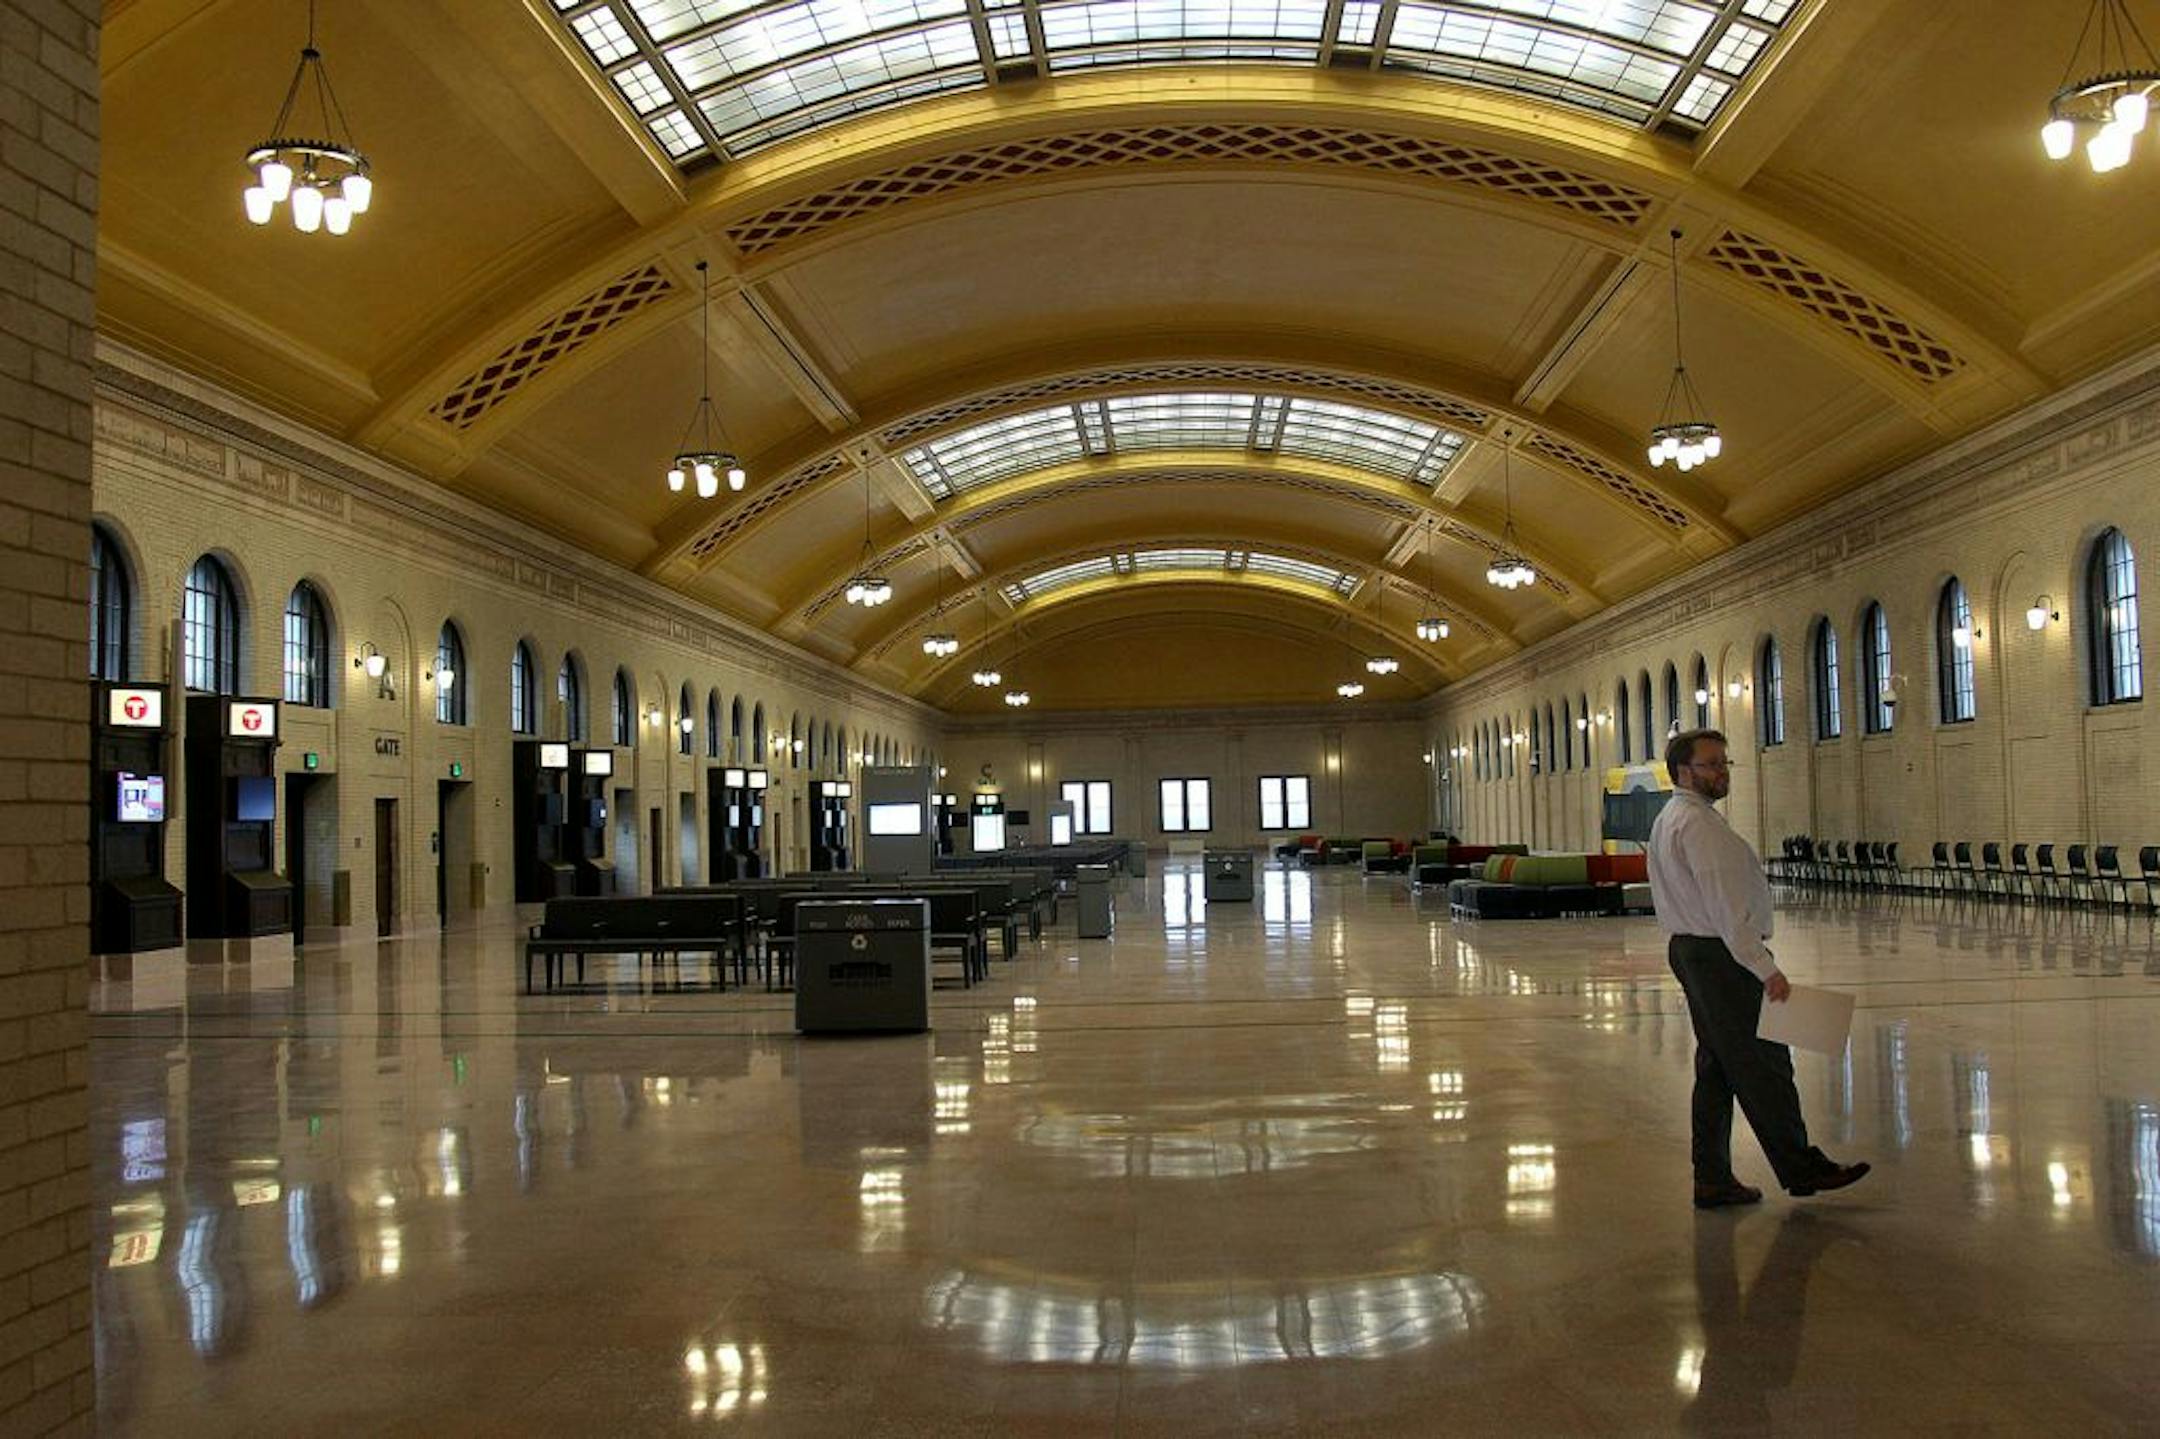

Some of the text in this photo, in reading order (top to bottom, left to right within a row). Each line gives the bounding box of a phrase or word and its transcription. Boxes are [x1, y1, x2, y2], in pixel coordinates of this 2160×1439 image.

[378, 656, 396, 700] A
[124, 697, 147, 719] T
[242, 710, 262, 730] T
[375, 736, 401, 756] GATE
